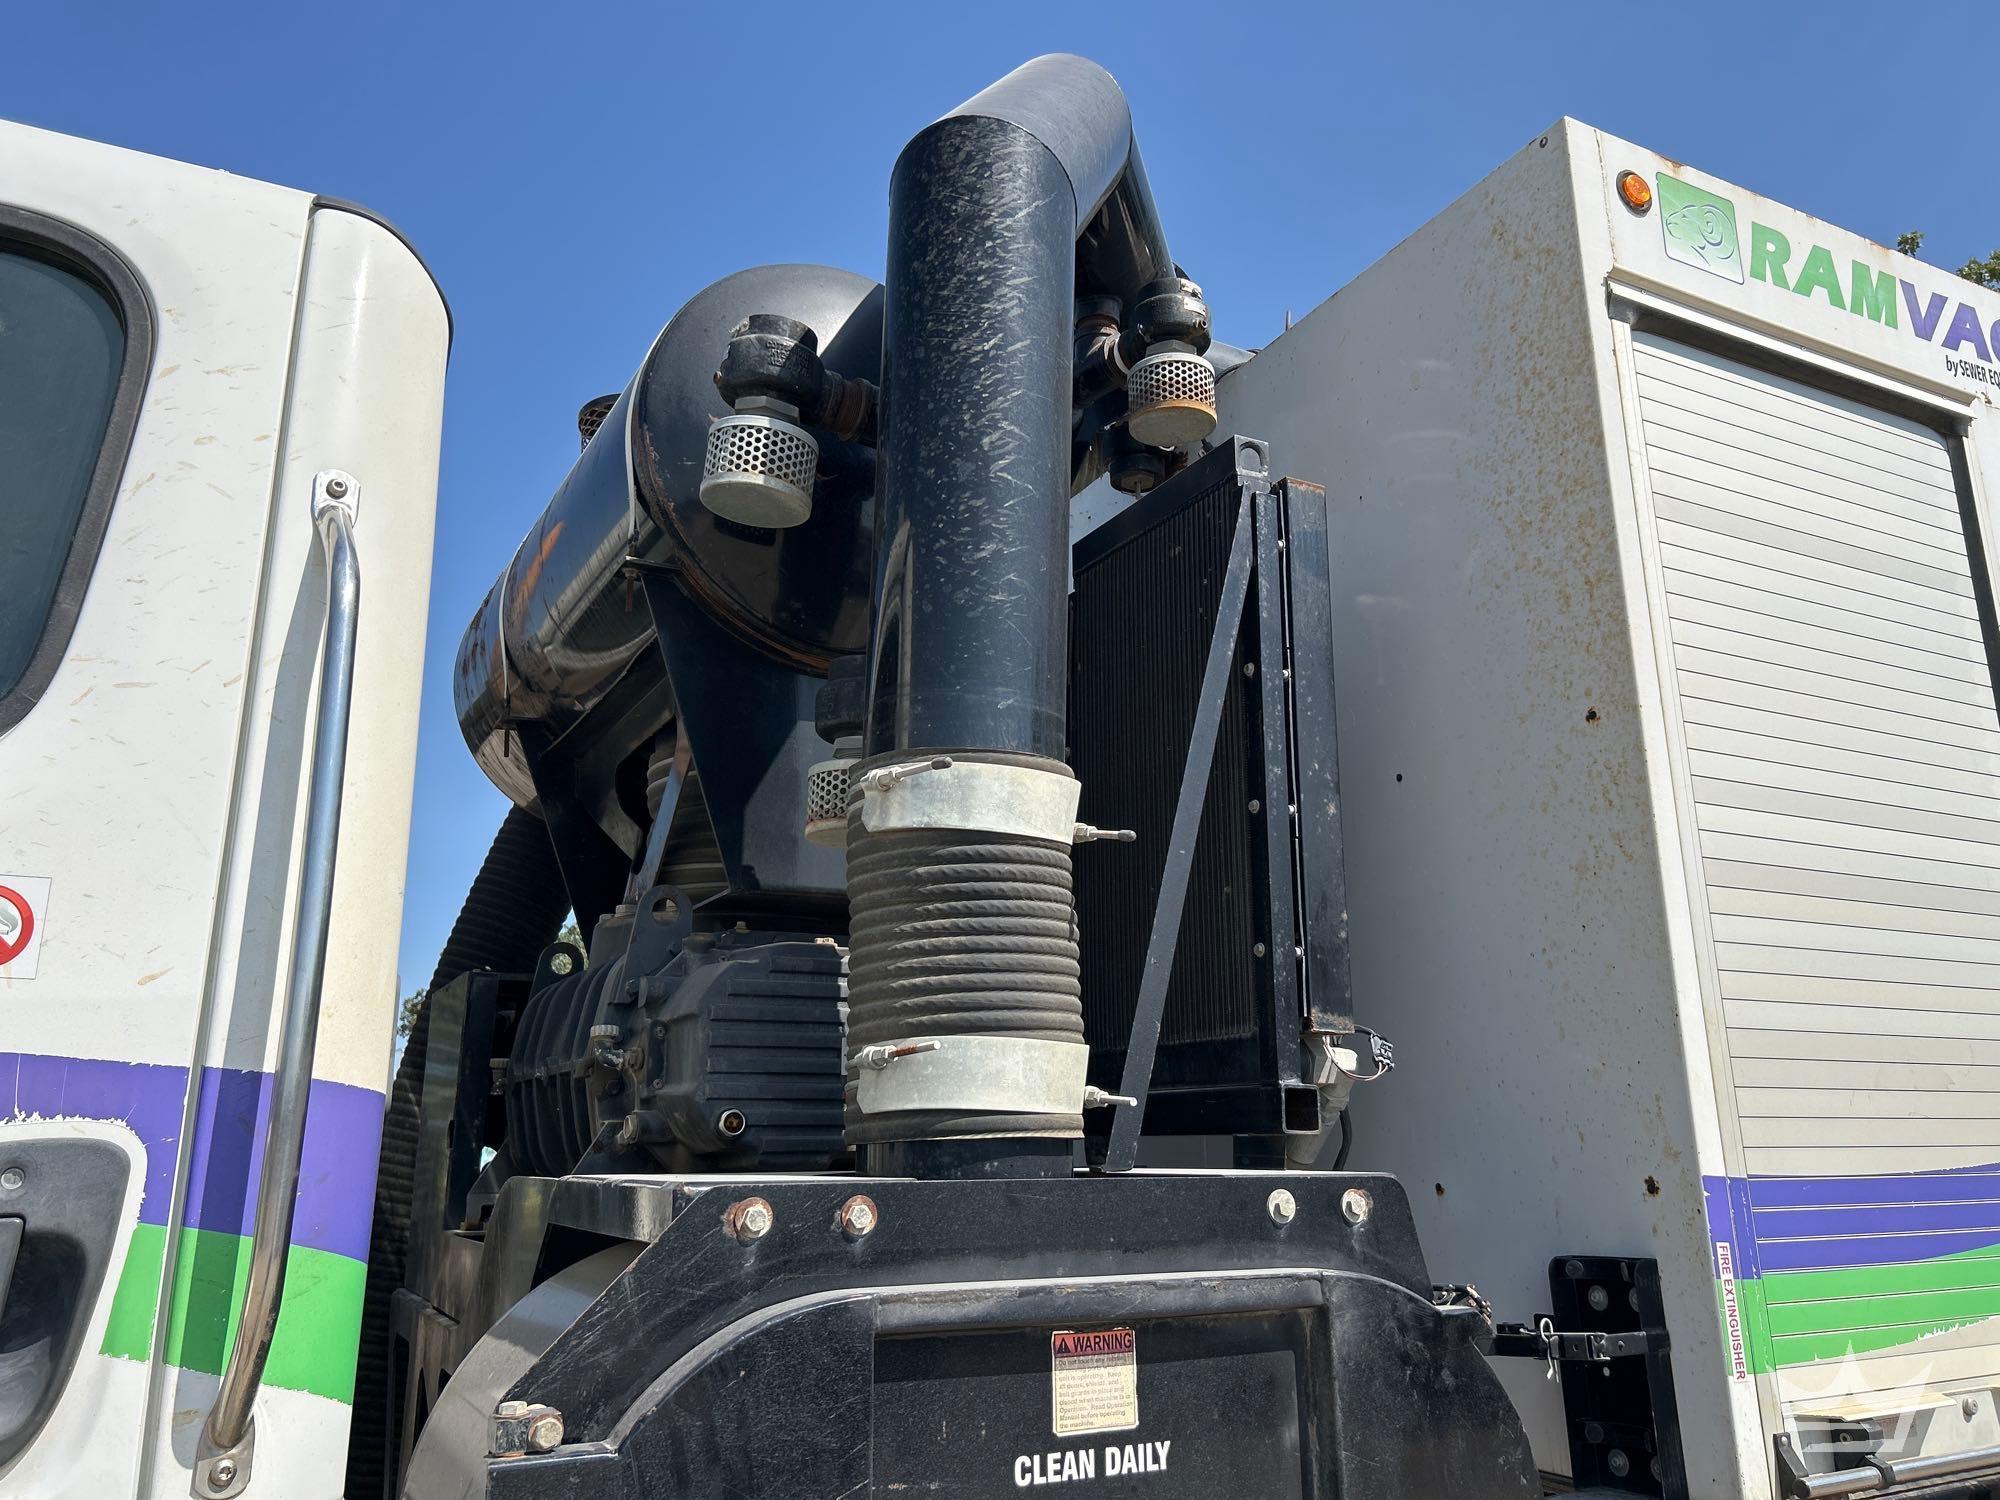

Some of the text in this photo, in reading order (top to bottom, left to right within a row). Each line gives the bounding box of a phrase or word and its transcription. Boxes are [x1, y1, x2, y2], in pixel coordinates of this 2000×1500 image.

[1750, 221, 2000, 365] RAMVA
[1945, 354, 2000, 390] by SEWER EQ
[1719, 1245, 1746, 1381] FIRE EXTINGUISHER
[1073, 1332, 1132, 1352] WARNING
[1014, 1440, 1171, 1487] CLEAN DAILY
